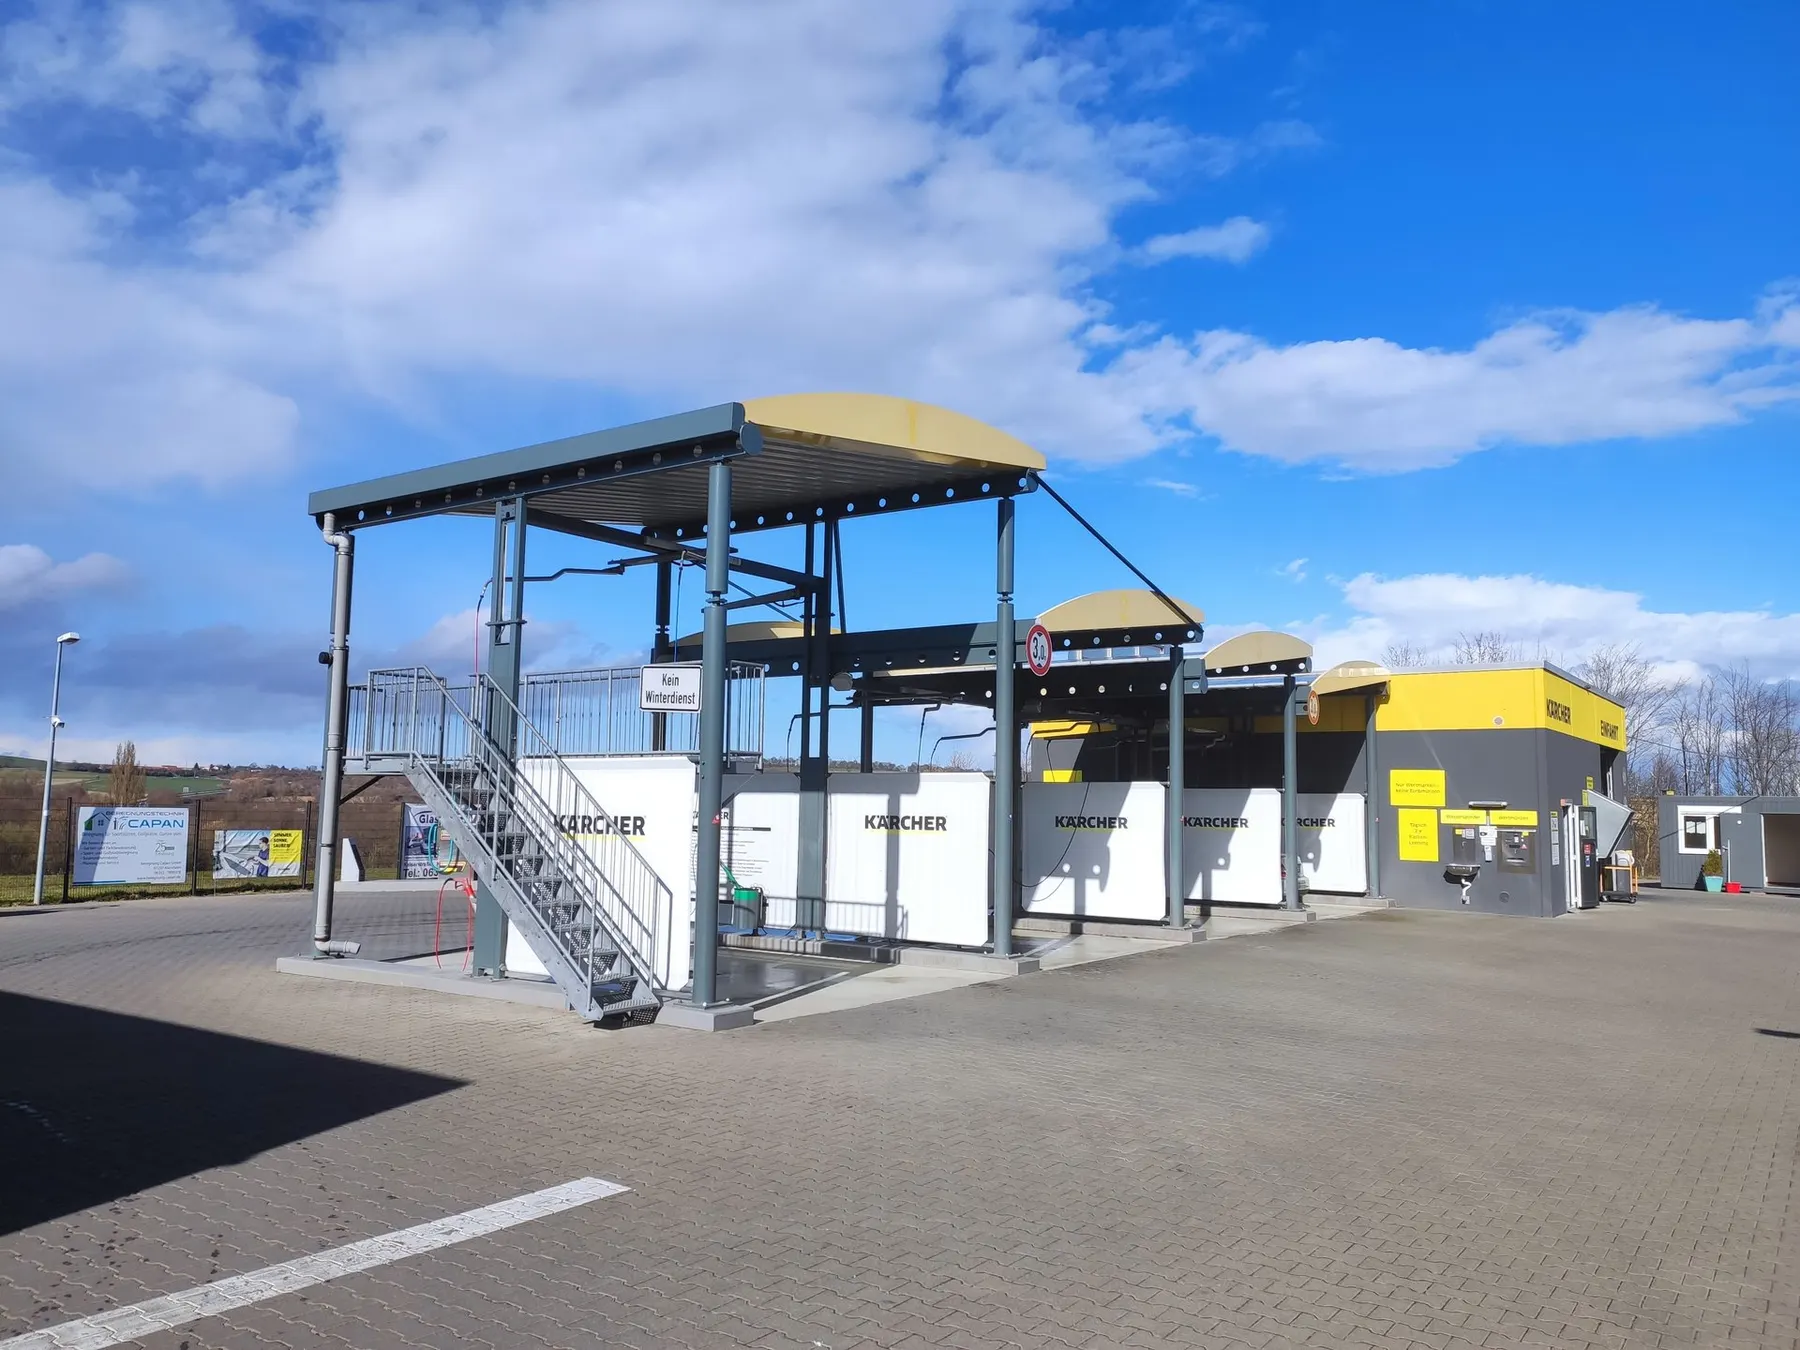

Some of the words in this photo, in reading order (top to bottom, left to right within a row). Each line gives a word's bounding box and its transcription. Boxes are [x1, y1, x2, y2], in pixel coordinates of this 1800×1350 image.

[662, 673, 680, 687] Kein
[646, 690, 695, 704] Winterdienst
[128, 819, 184, 828] CAPAN
[554, 814, 646, 836] KÄRCHER
[865, 815, 947, 831] KÄRCHER
[1055, 815, 1128, 829] KÄRCHER
[1184, 816, 1249, 829] KÄRCHER
[155, 842, 166, 853] 25
[403, 868, 420, 878] Tel.:
